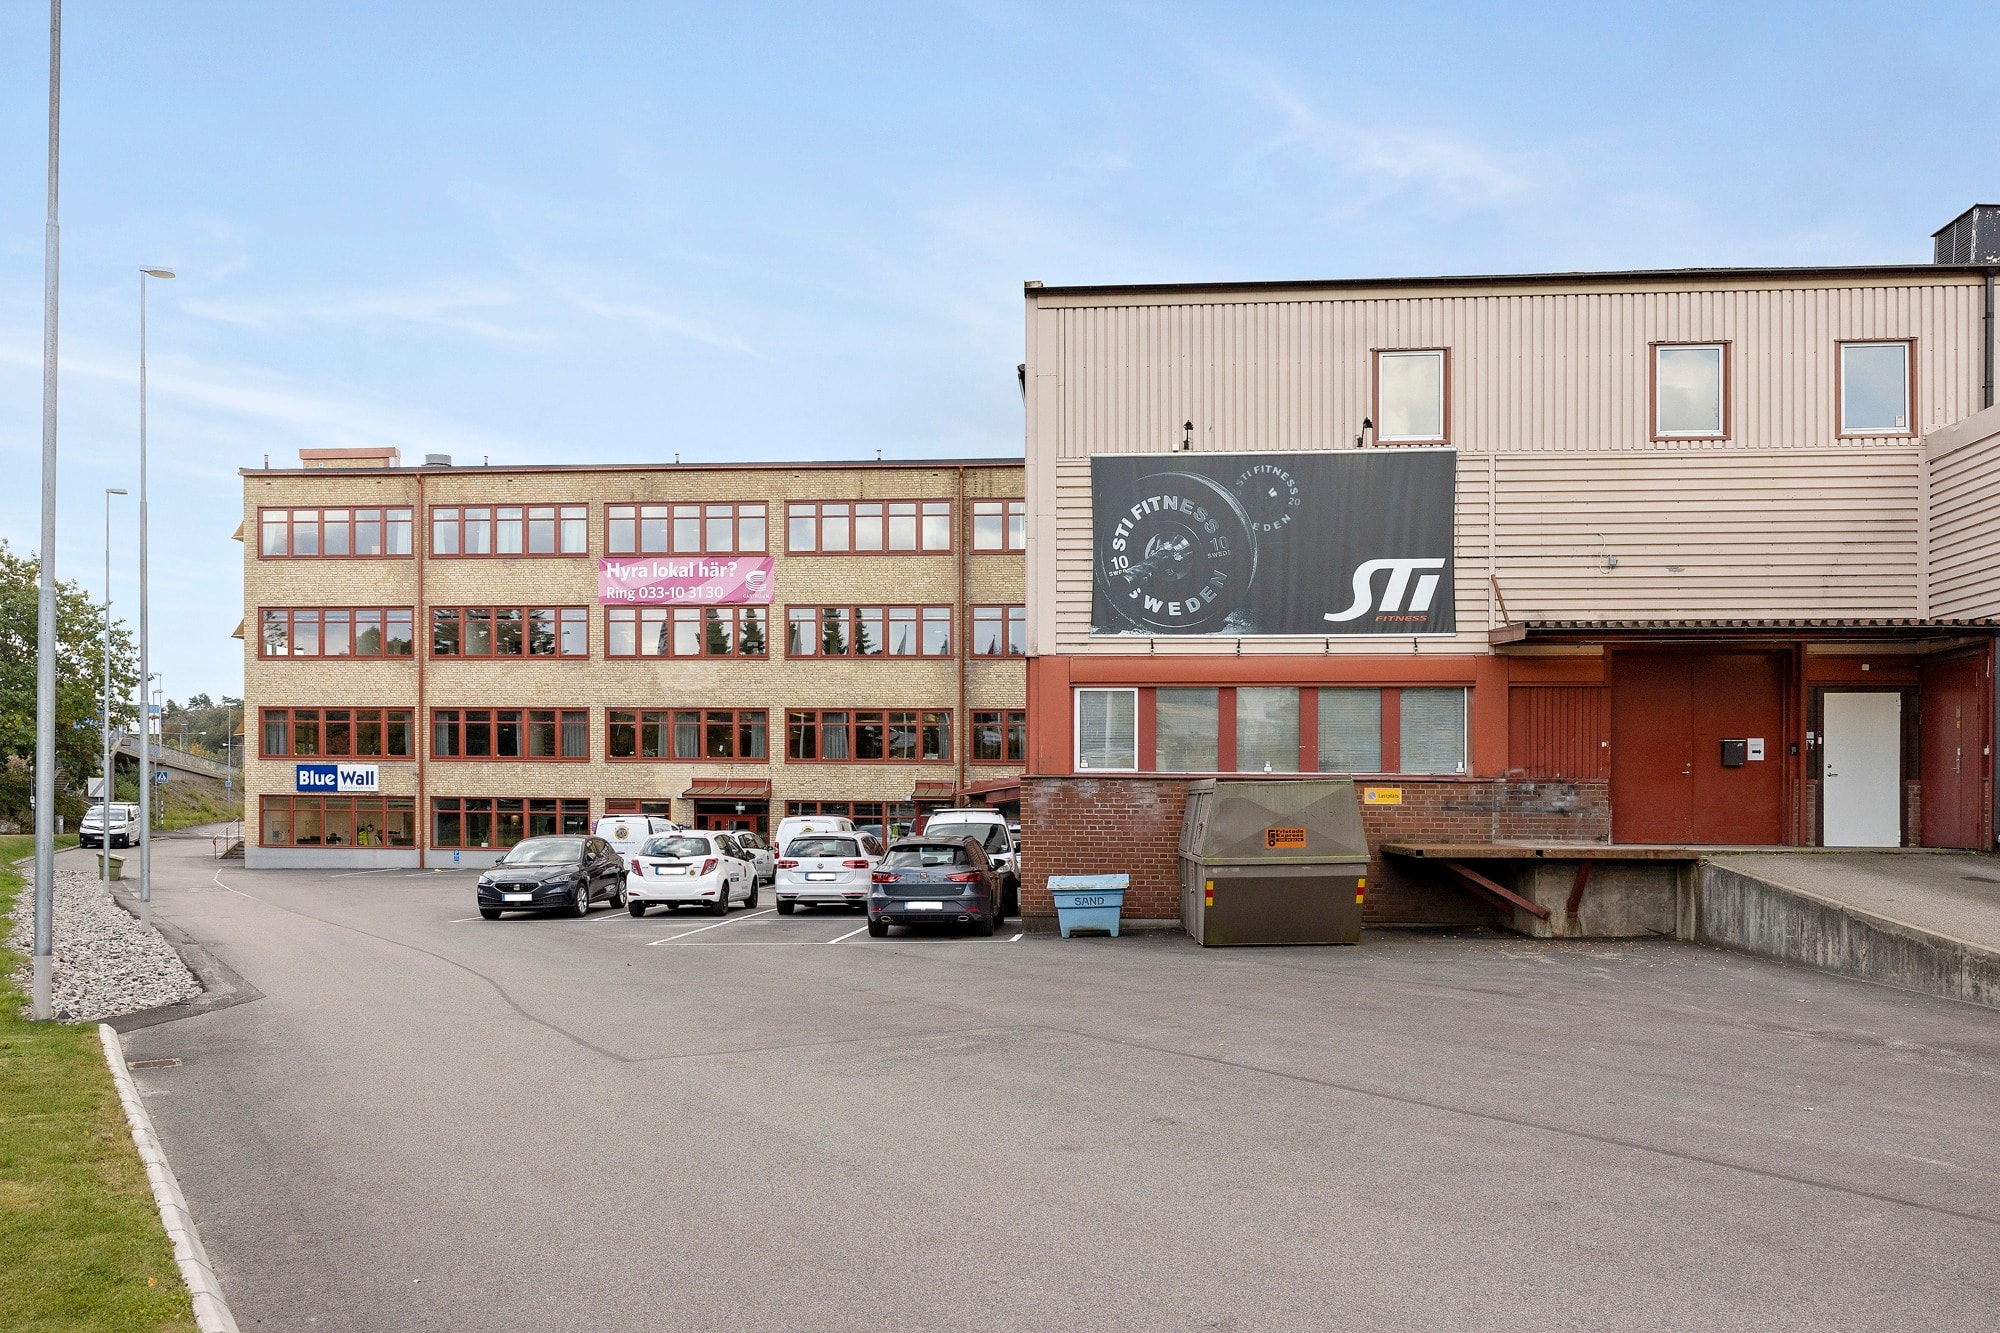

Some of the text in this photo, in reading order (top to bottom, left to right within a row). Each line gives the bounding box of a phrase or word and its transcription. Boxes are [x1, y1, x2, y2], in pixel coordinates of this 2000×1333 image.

[1253, 465, 1298, 495] FITNESS
[1288, 497, 1301, 506] 20
[1112, 495, 1219, 552] STI FITNESS
[1209, 536, 1227, 551] 10
[1207, 549, 1232, 559] SWEDE
[1111, 555, 1129, 570] 10
[606, 561, 738, 581] Hyra lokal här?
[606, 586, 724, 601] Ring 033-10 31 30
[299, 770, 375, 786] Blue Wall
[1074, 896, 1105, 906] SAND
